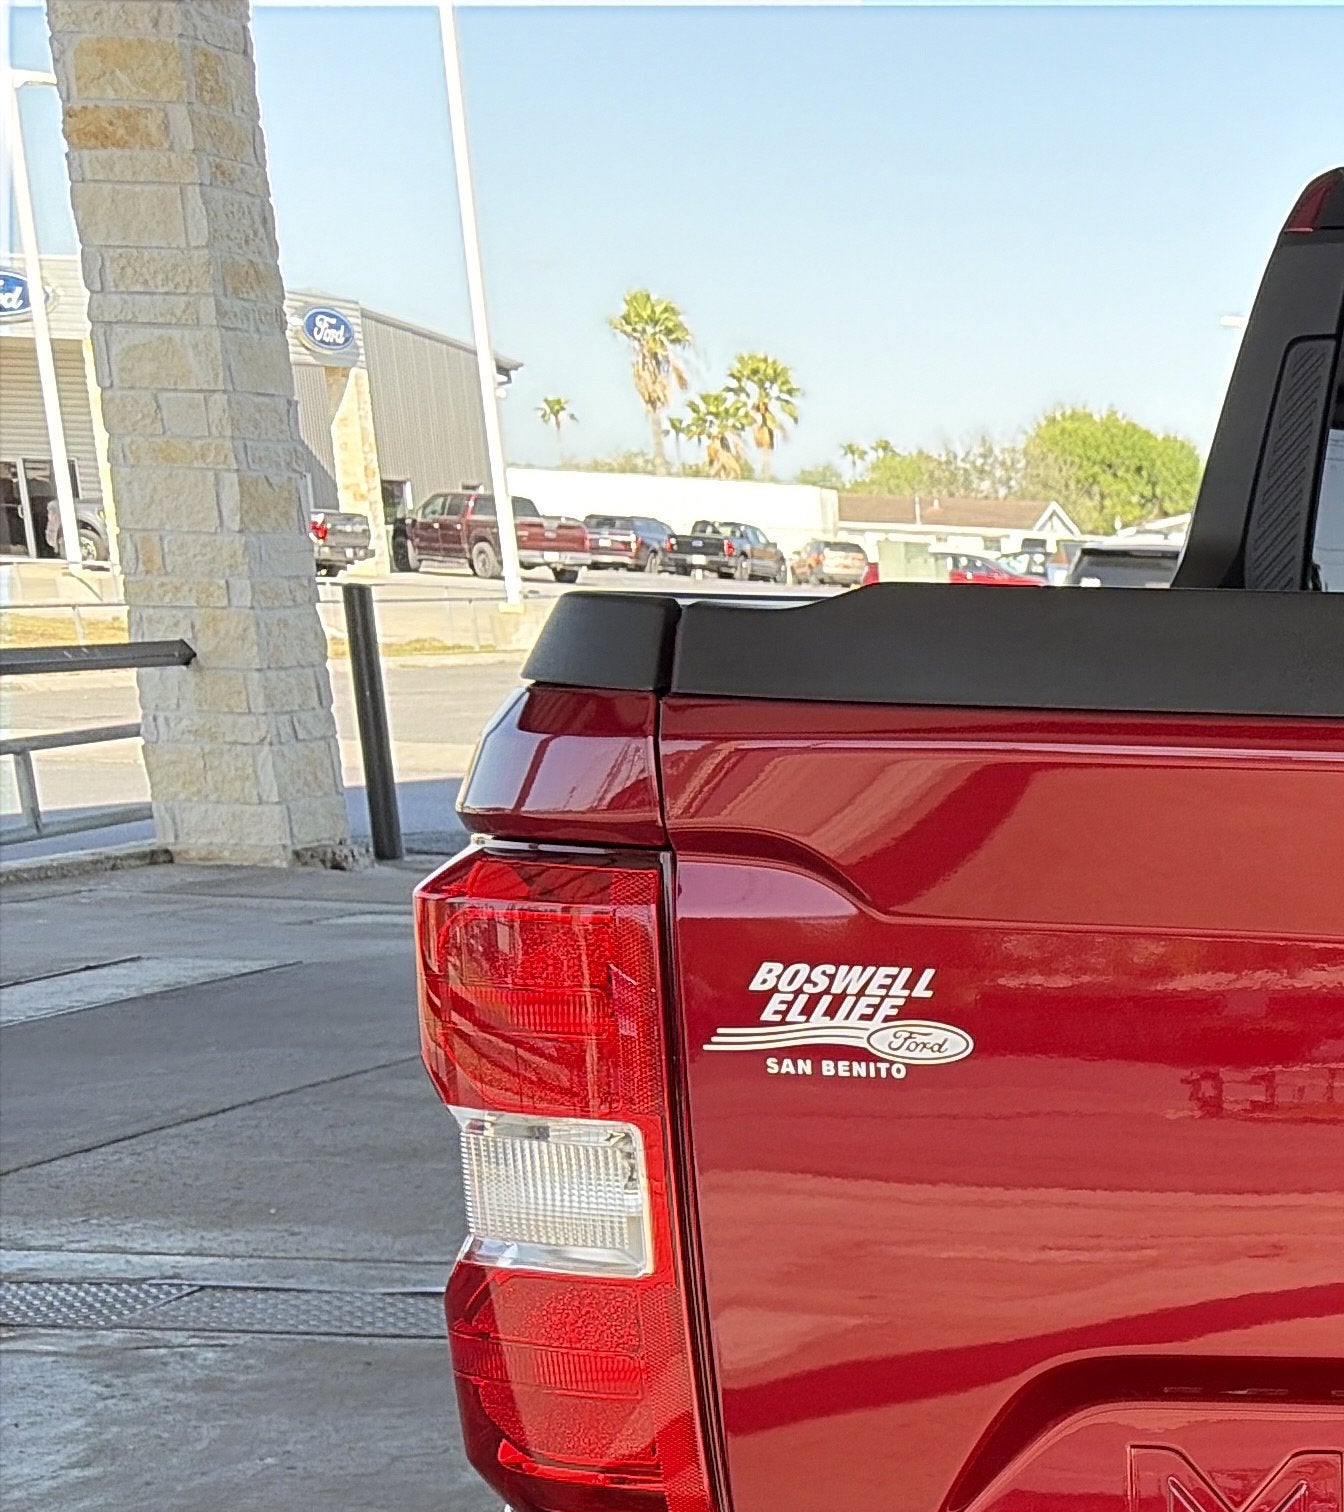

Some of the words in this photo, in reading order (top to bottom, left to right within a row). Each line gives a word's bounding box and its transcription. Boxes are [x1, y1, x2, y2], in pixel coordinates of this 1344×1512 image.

[313, 314, 345, 344] Ford
[748, 961, 936, 998] BOSWELL
[759, 992, 906, 1025] ELLIFF
[887, 1029, 949, 1055] Ford
[765, 1056, 812, 1076] SAN
[821, 1060, 907, 1080] BENITO
